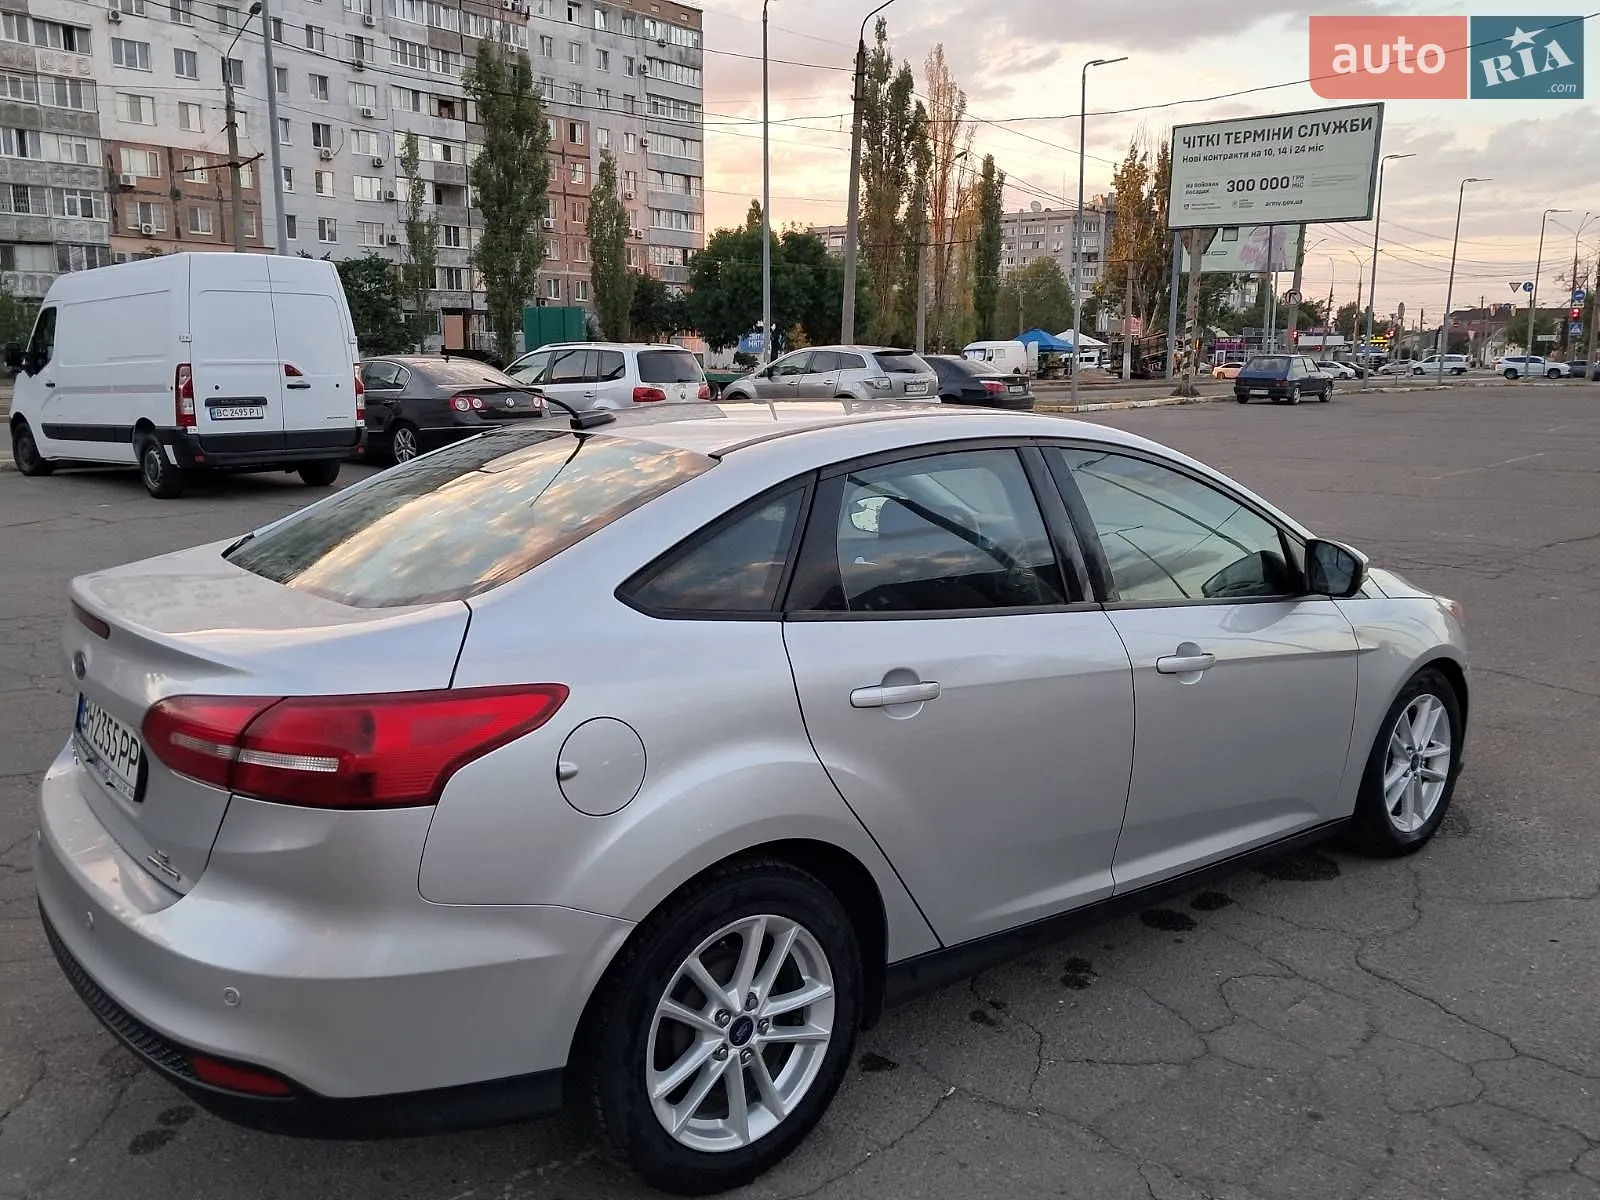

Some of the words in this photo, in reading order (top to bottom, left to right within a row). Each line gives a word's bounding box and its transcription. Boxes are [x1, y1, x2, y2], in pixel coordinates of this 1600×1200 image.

[1183, 133, 1220, 149] ЧІТКІ
[1224, 126, 1293, 145] ТЕРМІНИ
[1298, 117, 1373, 138] СЛУЖБИ
[1182, 154, 1201, 163] Нові
[1203, 151, 1249, 161] контракти
[1251, 149, 1262, 157] на
[1264, 148, 1275, 157] 10,
[1278, 147, 1287, 155] 14
[1294, 145, 1306, 154] 24
[1308, 144, 1325, 152] міс
[1227, 178, 1256, 193] 300
[1260, 176, 1290, 191] 000
[216, 408, 229, 417] BC
[229, 408, 248, 417] 2495
[94, 707, 119, 762] 2355
[118, 728, 139, 777] PP
